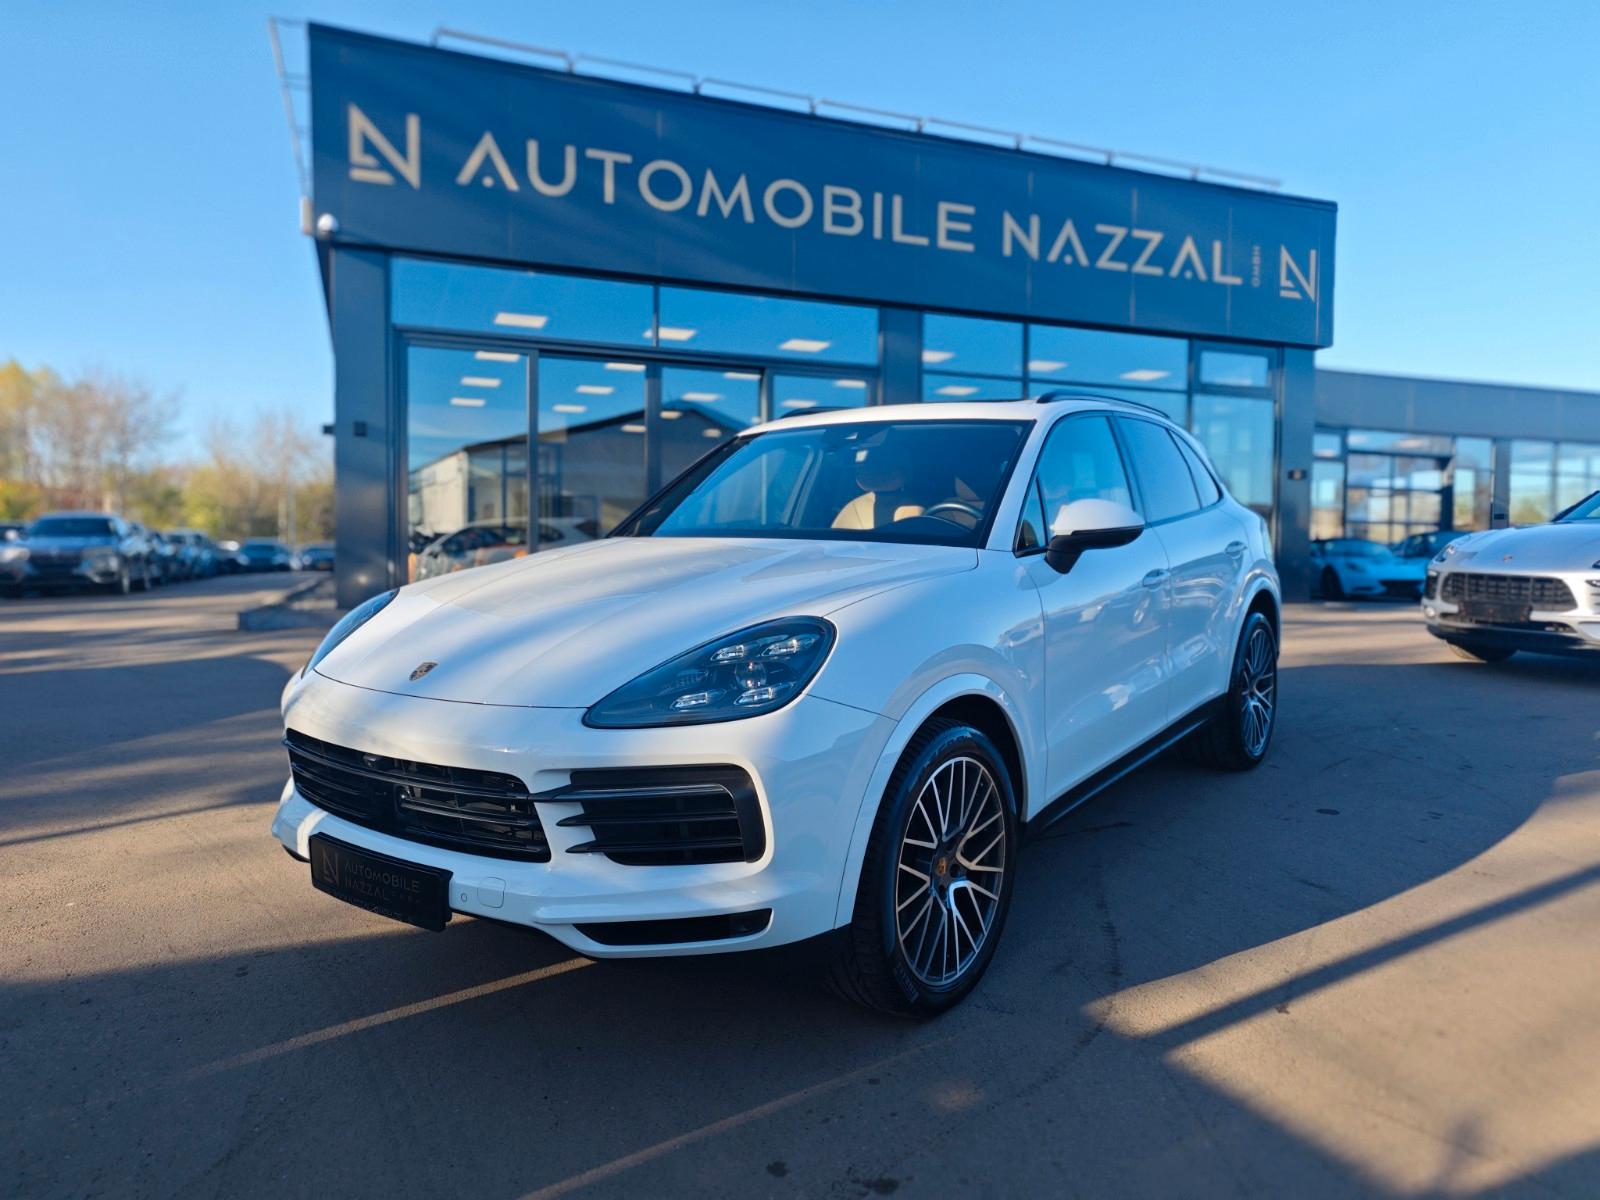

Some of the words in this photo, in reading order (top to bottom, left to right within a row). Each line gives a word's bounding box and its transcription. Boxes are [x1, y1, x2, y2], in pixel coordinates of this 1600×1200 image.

[456, 130, 976, 252] AUTOMOBILE
[1002, 210, 1243, 286] NAZZAL
[344, 861, 420, 893] AUTOMOBILE
[344, 876, 393, 904] NAZZAL
